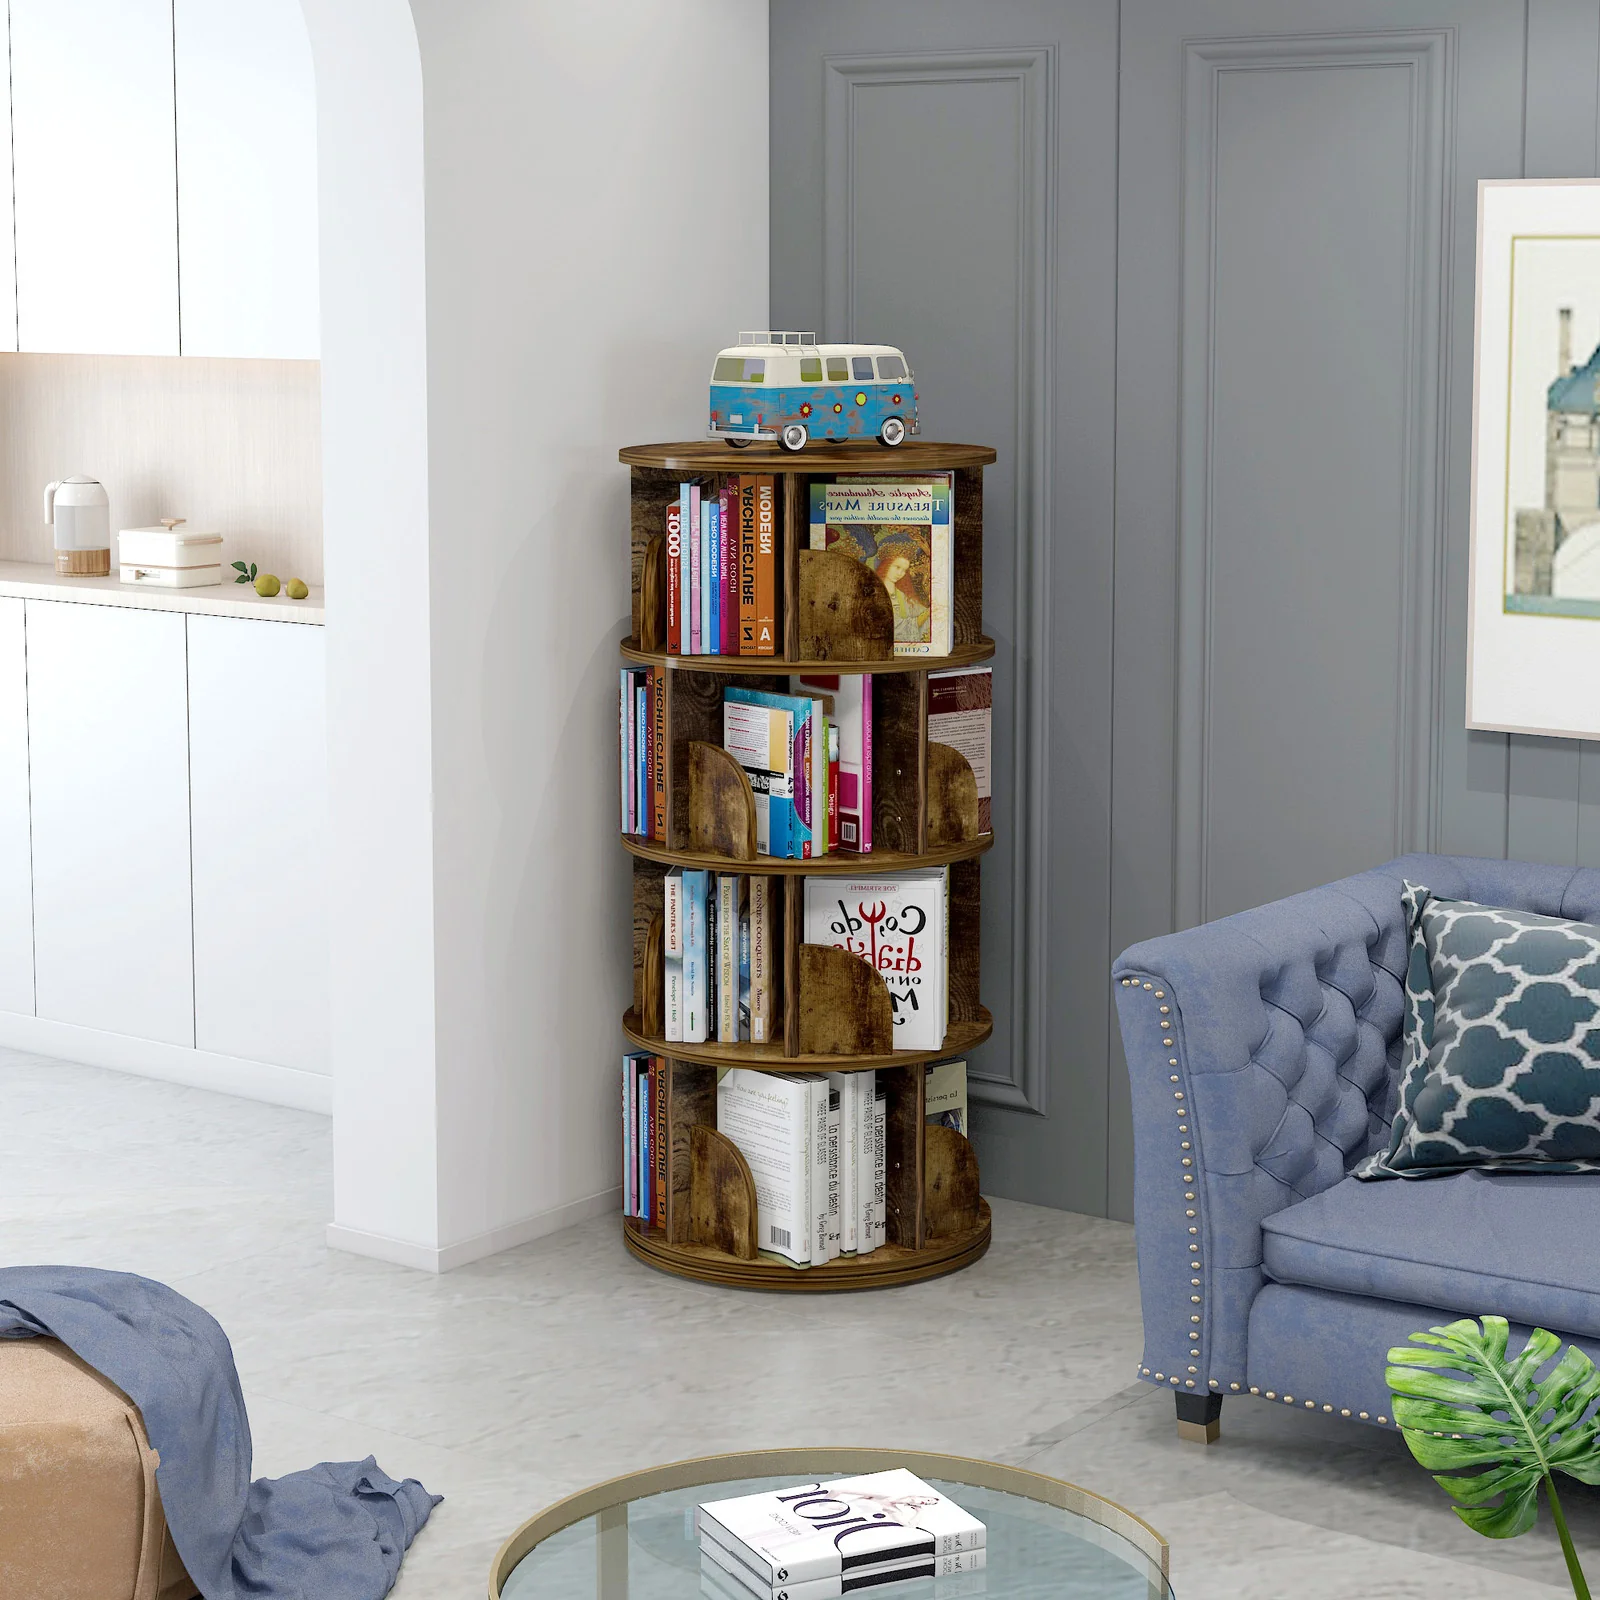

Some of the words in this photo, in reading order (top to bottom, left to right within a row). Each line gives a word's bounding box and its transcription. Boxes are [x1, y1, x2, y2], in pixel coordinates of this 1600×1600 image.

[723, 885, 731, 906] PEARLS
[723, 937, 731, 951] SEAT
[724, 953, 729, 961] OF
[755, 927, 763, 979] CONQUESTS
[723, 962, 731, 986] WISDOM
[864, 1089, 873, 1106] THREE
[817, 1099, 826, 1116] THREE
[864, 1107, 873, 1122] PAIRS
[817, 1117, 826, 1132] PAIRS
[876, 1115, 885, 1124] La
[829, 1124, 840, 1134] La
[864, 1131, 873, 1154] GLASSES
[876, 1126, 885, 1167] persistance
[817, 1142, 826, 1165] GLASSES
[829, 1136, 840, 1179] persistance
[876, 1170, 885, 1180] du
[829, 1181, 840, 1192] du
[876, 1182, 885, 1204] destin
[829, 1193, 840, 1216] destin
